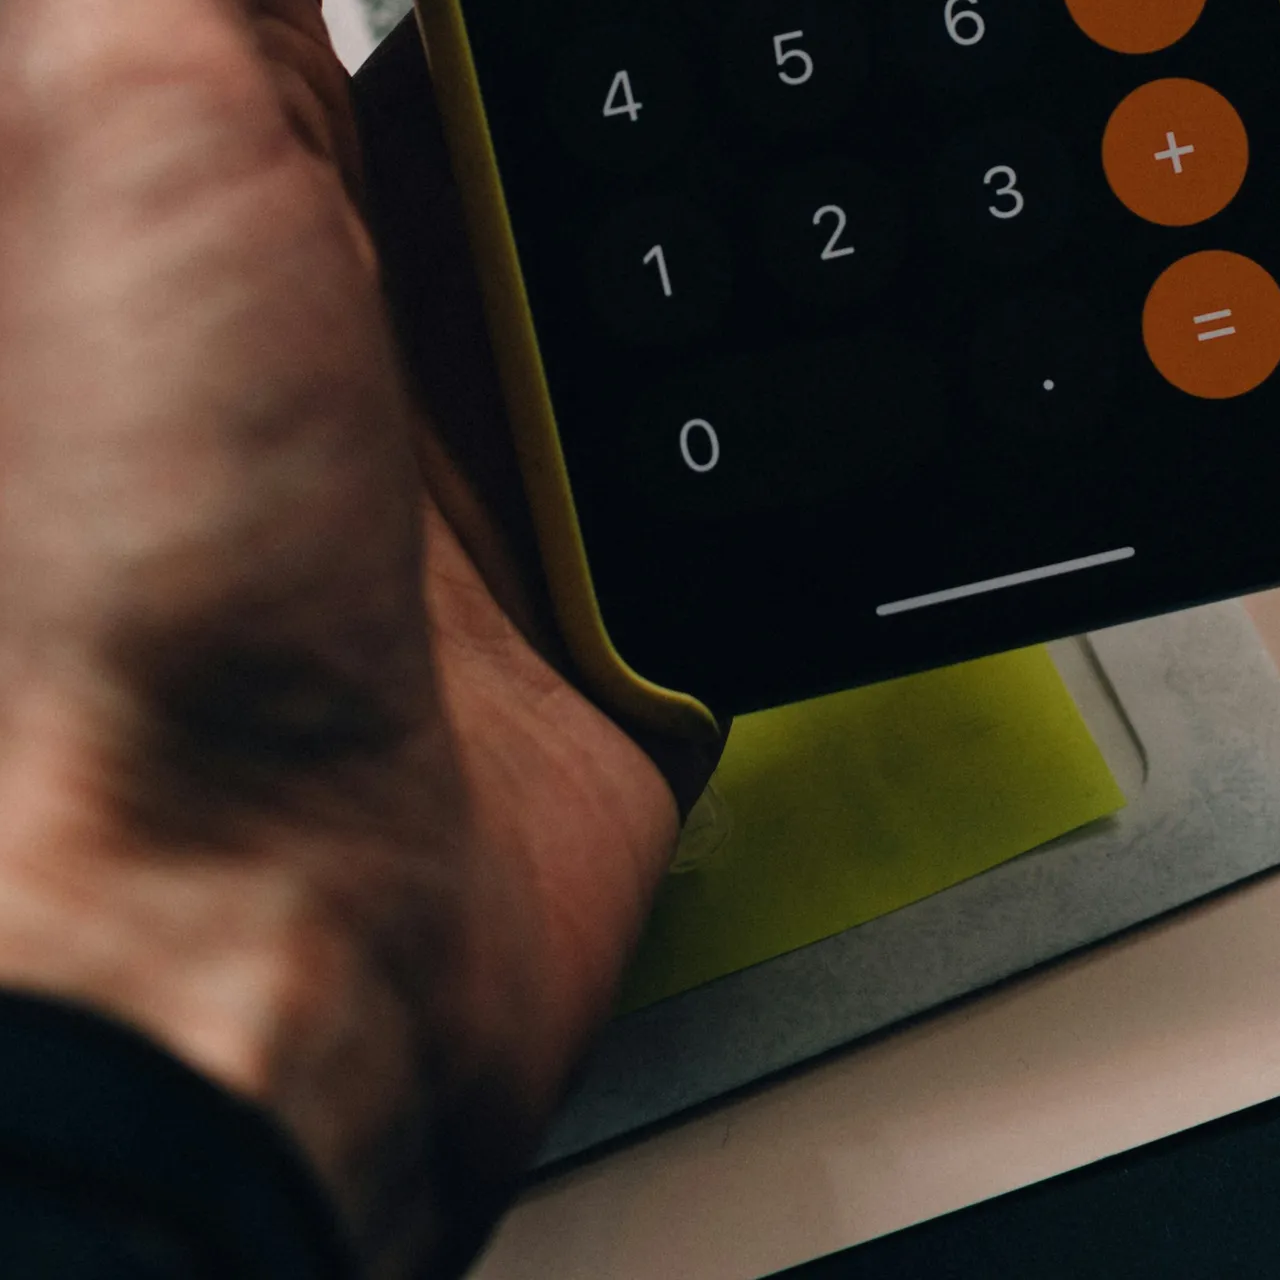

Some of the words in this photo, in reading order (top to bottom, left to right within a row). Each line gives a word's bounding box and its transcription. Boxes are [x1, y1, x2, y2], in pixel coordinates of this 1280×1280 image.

[601, 69, 644, 122] 4
[772, 29, 815, 86] 5
[642, 243, 674, 298] 1
[811, 203, 856, 261] 2
[981, 164, 1025, 219] 3
[678, 417, 721, 473] 0
